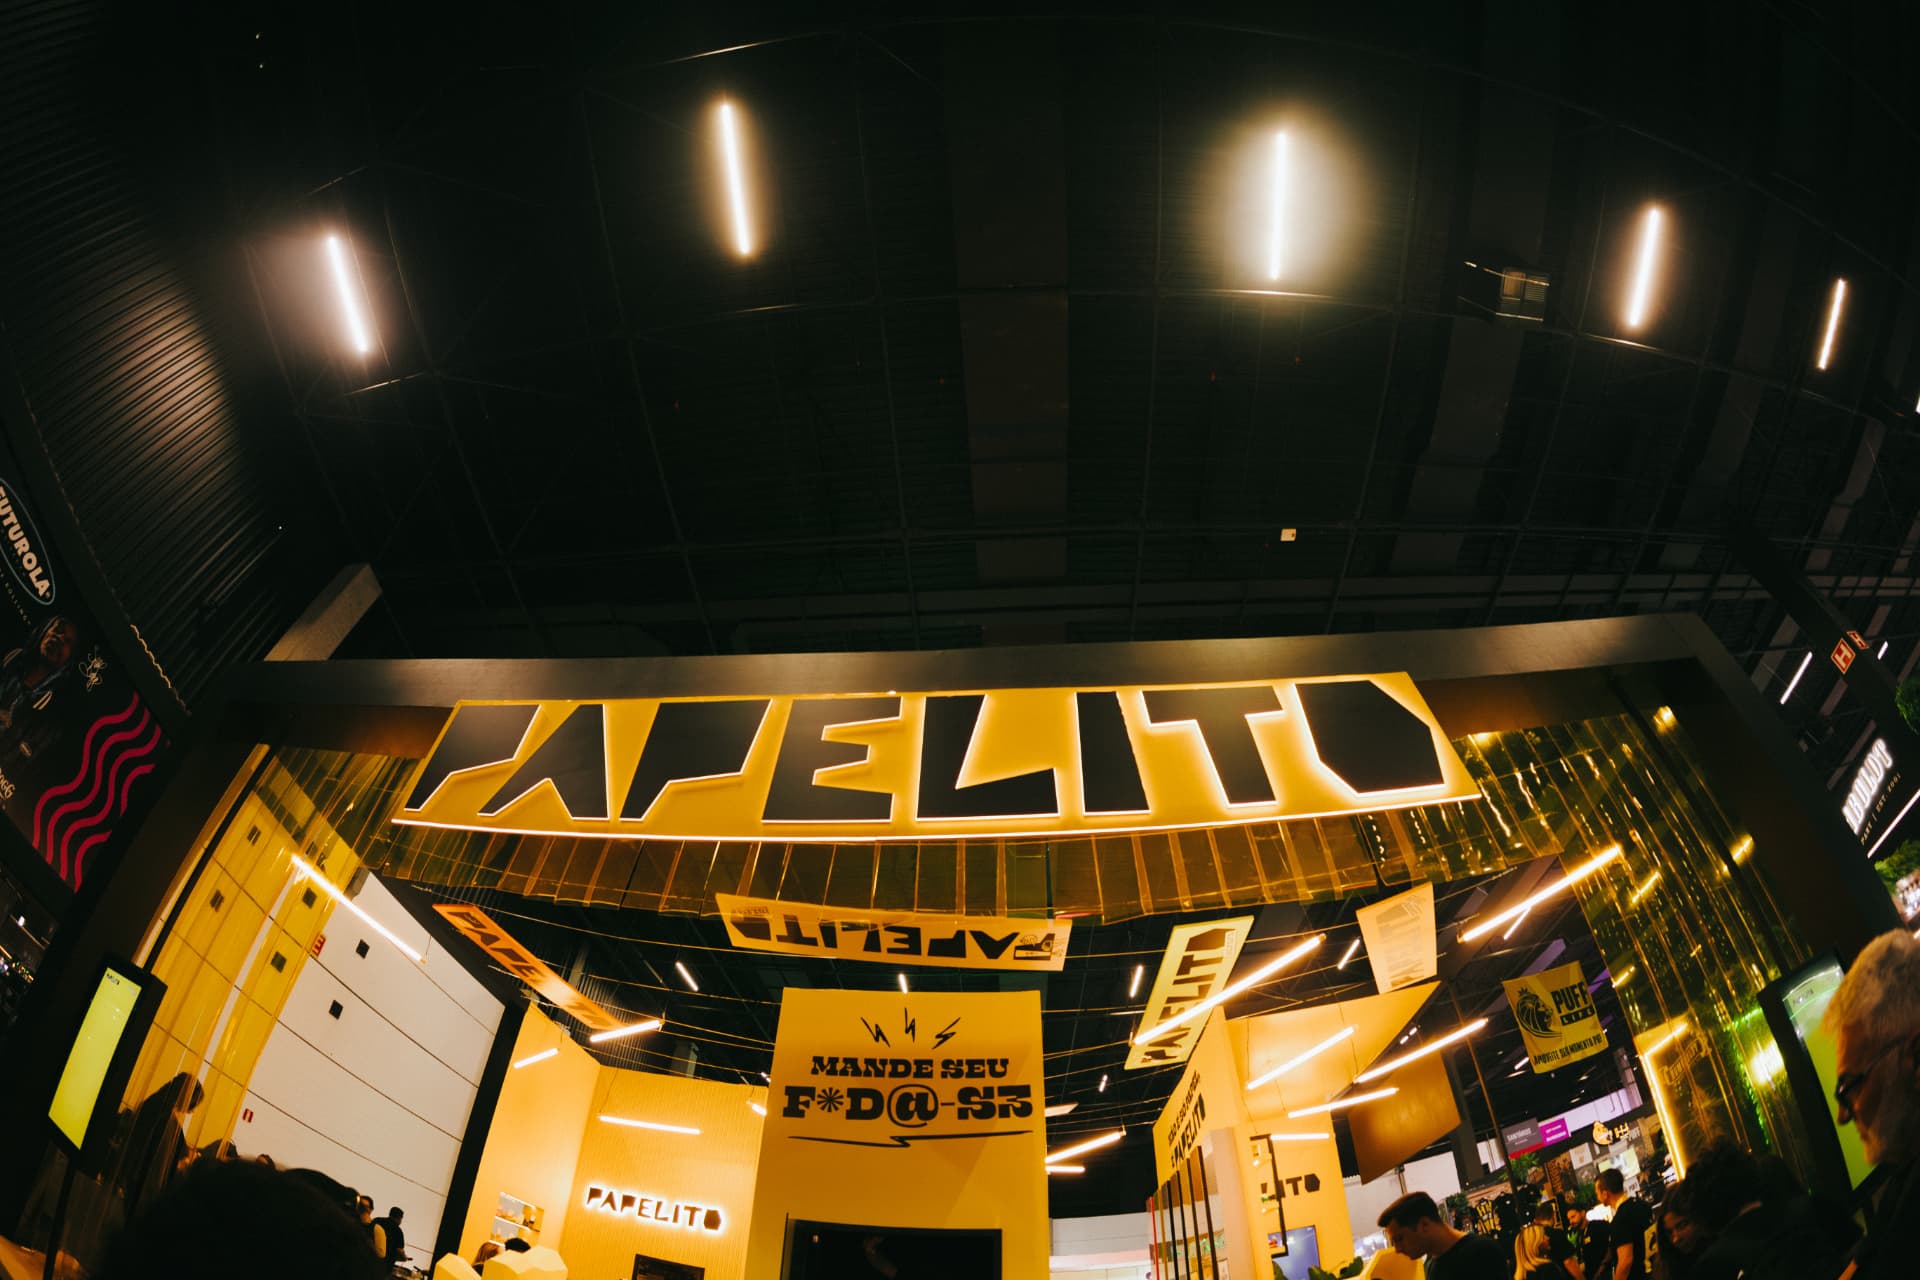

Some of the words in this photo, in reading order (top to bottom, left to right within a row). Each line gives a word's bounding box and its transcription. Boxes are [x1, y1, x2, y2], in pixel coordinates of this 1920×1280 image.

[404, 680, 1445, 823] PAPELITO
[731, 912, 1056, 961] PAPELITO
[1551, 981, 1589, 1015] PUFF
[811, 1056, 933, 1078] MANDE
[941, 1058, 1009, 1079] SEU
[586, 1187, 722, 1231] PAPELITO
